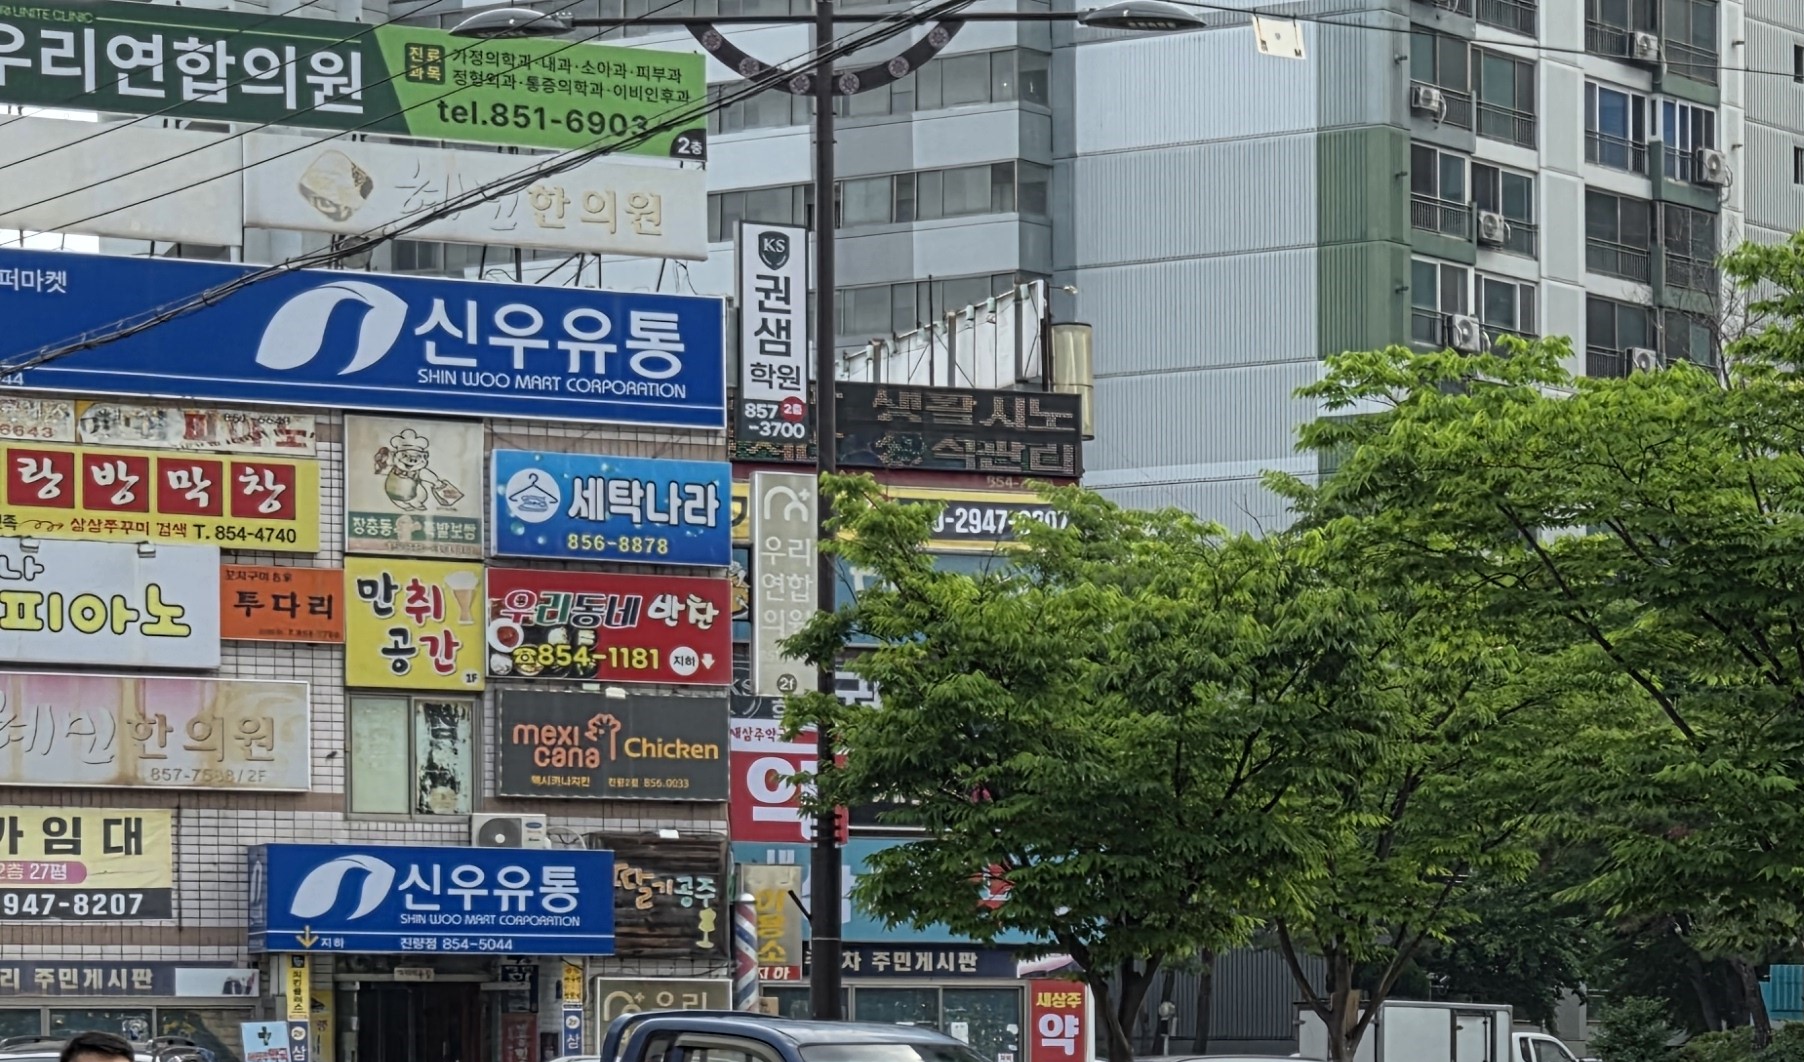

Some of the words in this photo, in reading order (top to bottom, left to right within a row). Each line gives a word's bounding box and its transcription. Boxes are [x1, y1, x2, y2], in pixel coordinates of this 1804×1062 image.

[0, 22, 364, 114] 우리연합의원
[408, 46, 440, 61] 진료
[408, 66, 441, 81] 과목
[437, 99, 651, 138] tel.851-6903
[527, 184, 664, 236] 한의원
[762, 238, 786, 254] KS
[0, 268, 67, 293] 퍼마켓
[754, 273, 792, 358] 권샘
[414, 298, 685, 379] 신우유통
[418, 369, 457, 385] SHIN
[462, 371, 510, 388] WOO
[515, 375, 561, 391] MART
[566, 378, 686, 398] CORPORATION
[750, 361, 801, 392] 학원
[744, 403, 779, 419] 857
[749, 421, 806, 439] -3700
[568, 475, 721, 528] 세탁나라
[157, 522, 187, 537] 검색
[214, 525, 297, 543] 854-4740
[567, 534, 669, 555] 856-8878
[760, 535, 812, 567] 우리
[357, 571, 445, 626] 만취
[762, 573, 813, 603] 연합
[0, 583, 191, 637] 피아노
[233, 591, 333, 620] 투다리
[501, 589, 643, 629] 우리동네
[381, 628, 462, 676] 공간
[537, 644, 660, 670] 854-1181
[672, 655, 696, 667] 지하
[126, 713, 275, 763] 한의원
[513, 724, 579, 746] mexi
[534, 746, 600, 769] cana
[623, 737, 720, 760] Chicken
[29, 863, 67, 881] 27평
[397, 863, 580, 913] 신우유통
[4, 893, 143, 916] 947-8207
[400, 913, 427, 926] SHIN
[430, 914, 462, 926] WOO
[464, 914, 496, 926] MART
[499, 914, 581, 928] CORPORATION
[320, 936, 345, 949] 지하
[400, 936, 437, 950] 진량점
[442, 937, 513, 952] 854-5044
[871, 951, 979, 973] 주민게시판
[34, 967, 154, 990] 주민게시판
